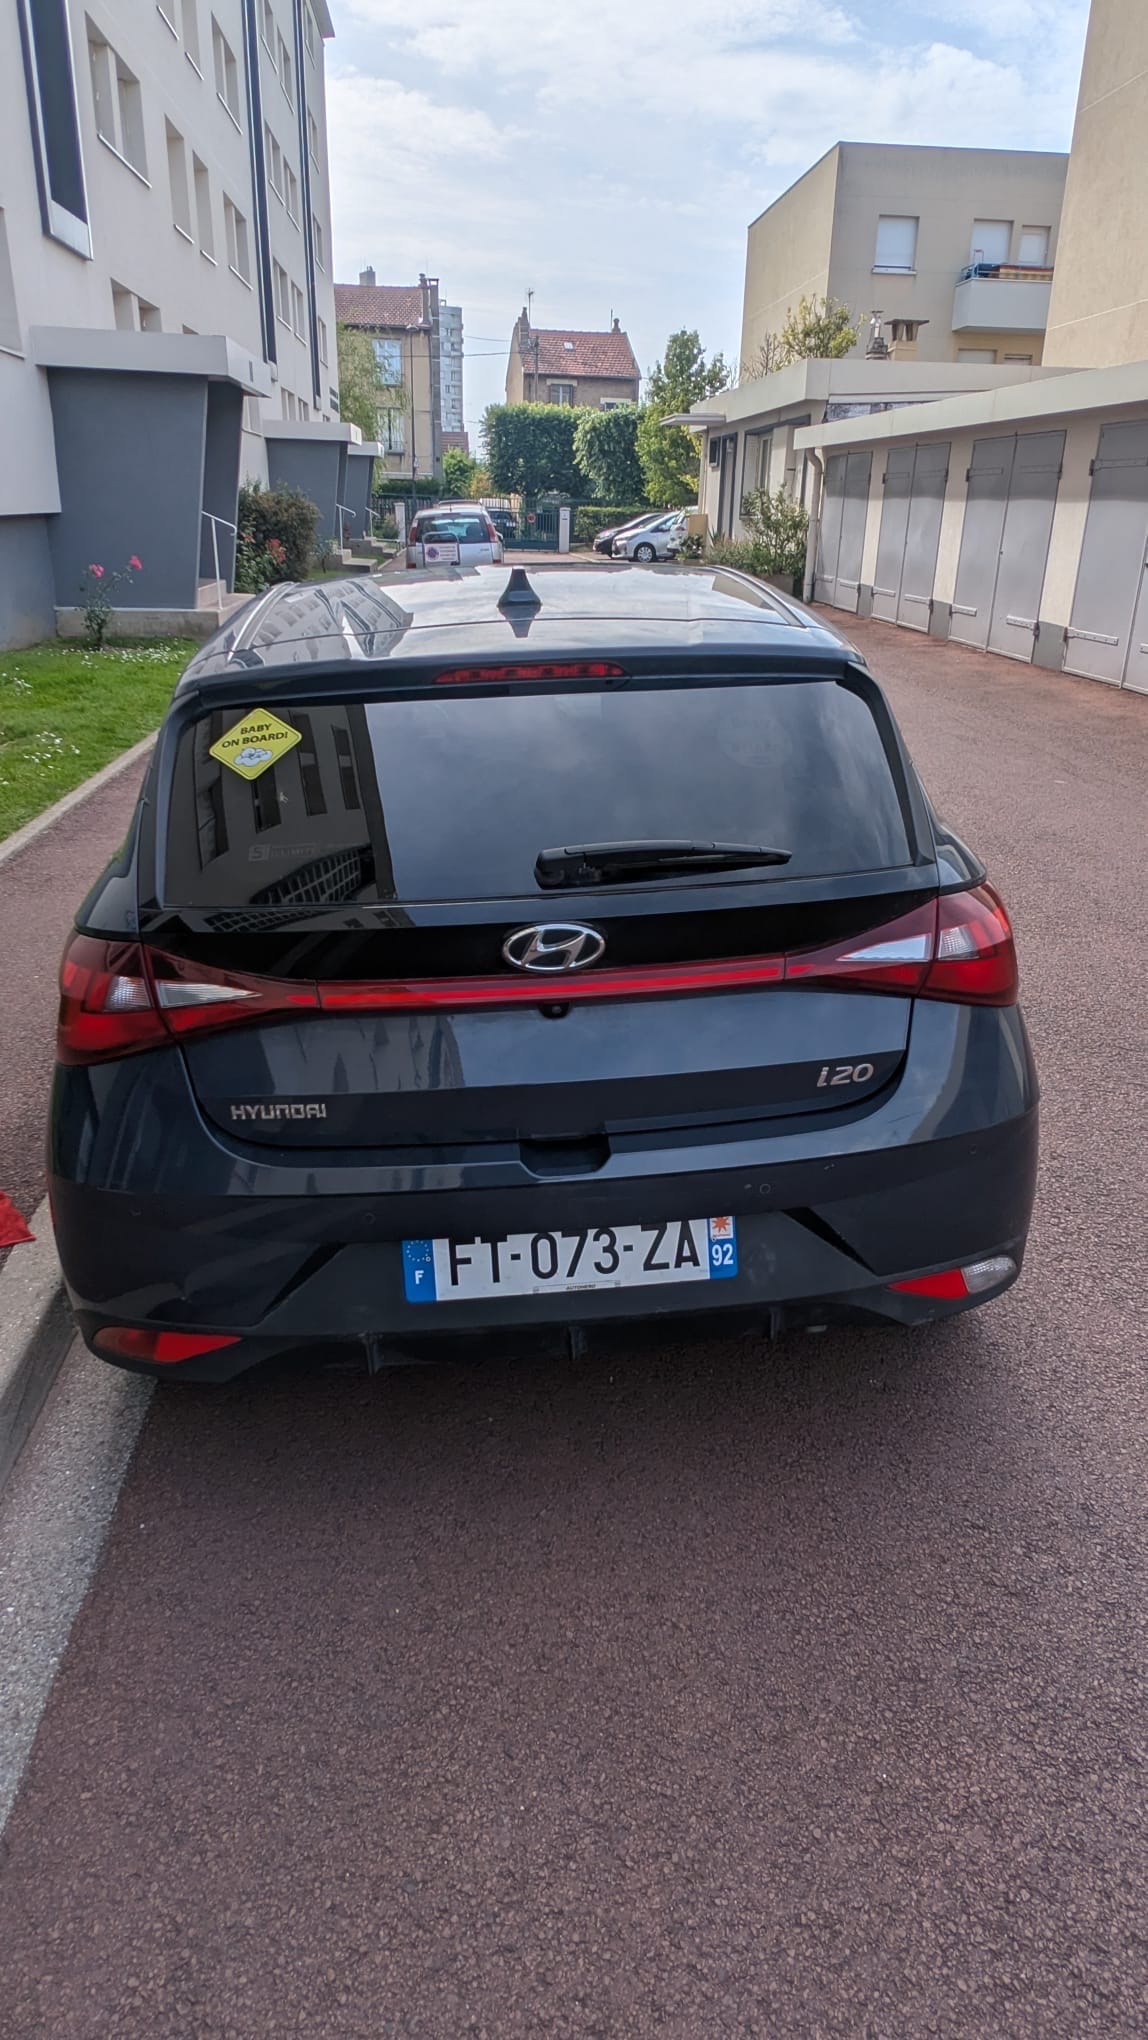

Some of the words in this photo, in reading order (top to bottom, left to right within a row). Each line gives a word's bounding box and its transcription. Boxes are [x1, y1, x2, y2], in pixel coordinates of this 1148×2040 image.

[240, 723, 272, 735] BABY
[222, 738, 240, 749] ON
[242, 731, 289, 745] BOARD!
[816, 1063, 874, 1088] i20
[230, 1103, 327, 1120] HYUNDAI
[415, 1270, 424, 1284] F
[448, 1220, 700, 1286] FT-073-ZA
[711, 1243, 734, 1266] 92
